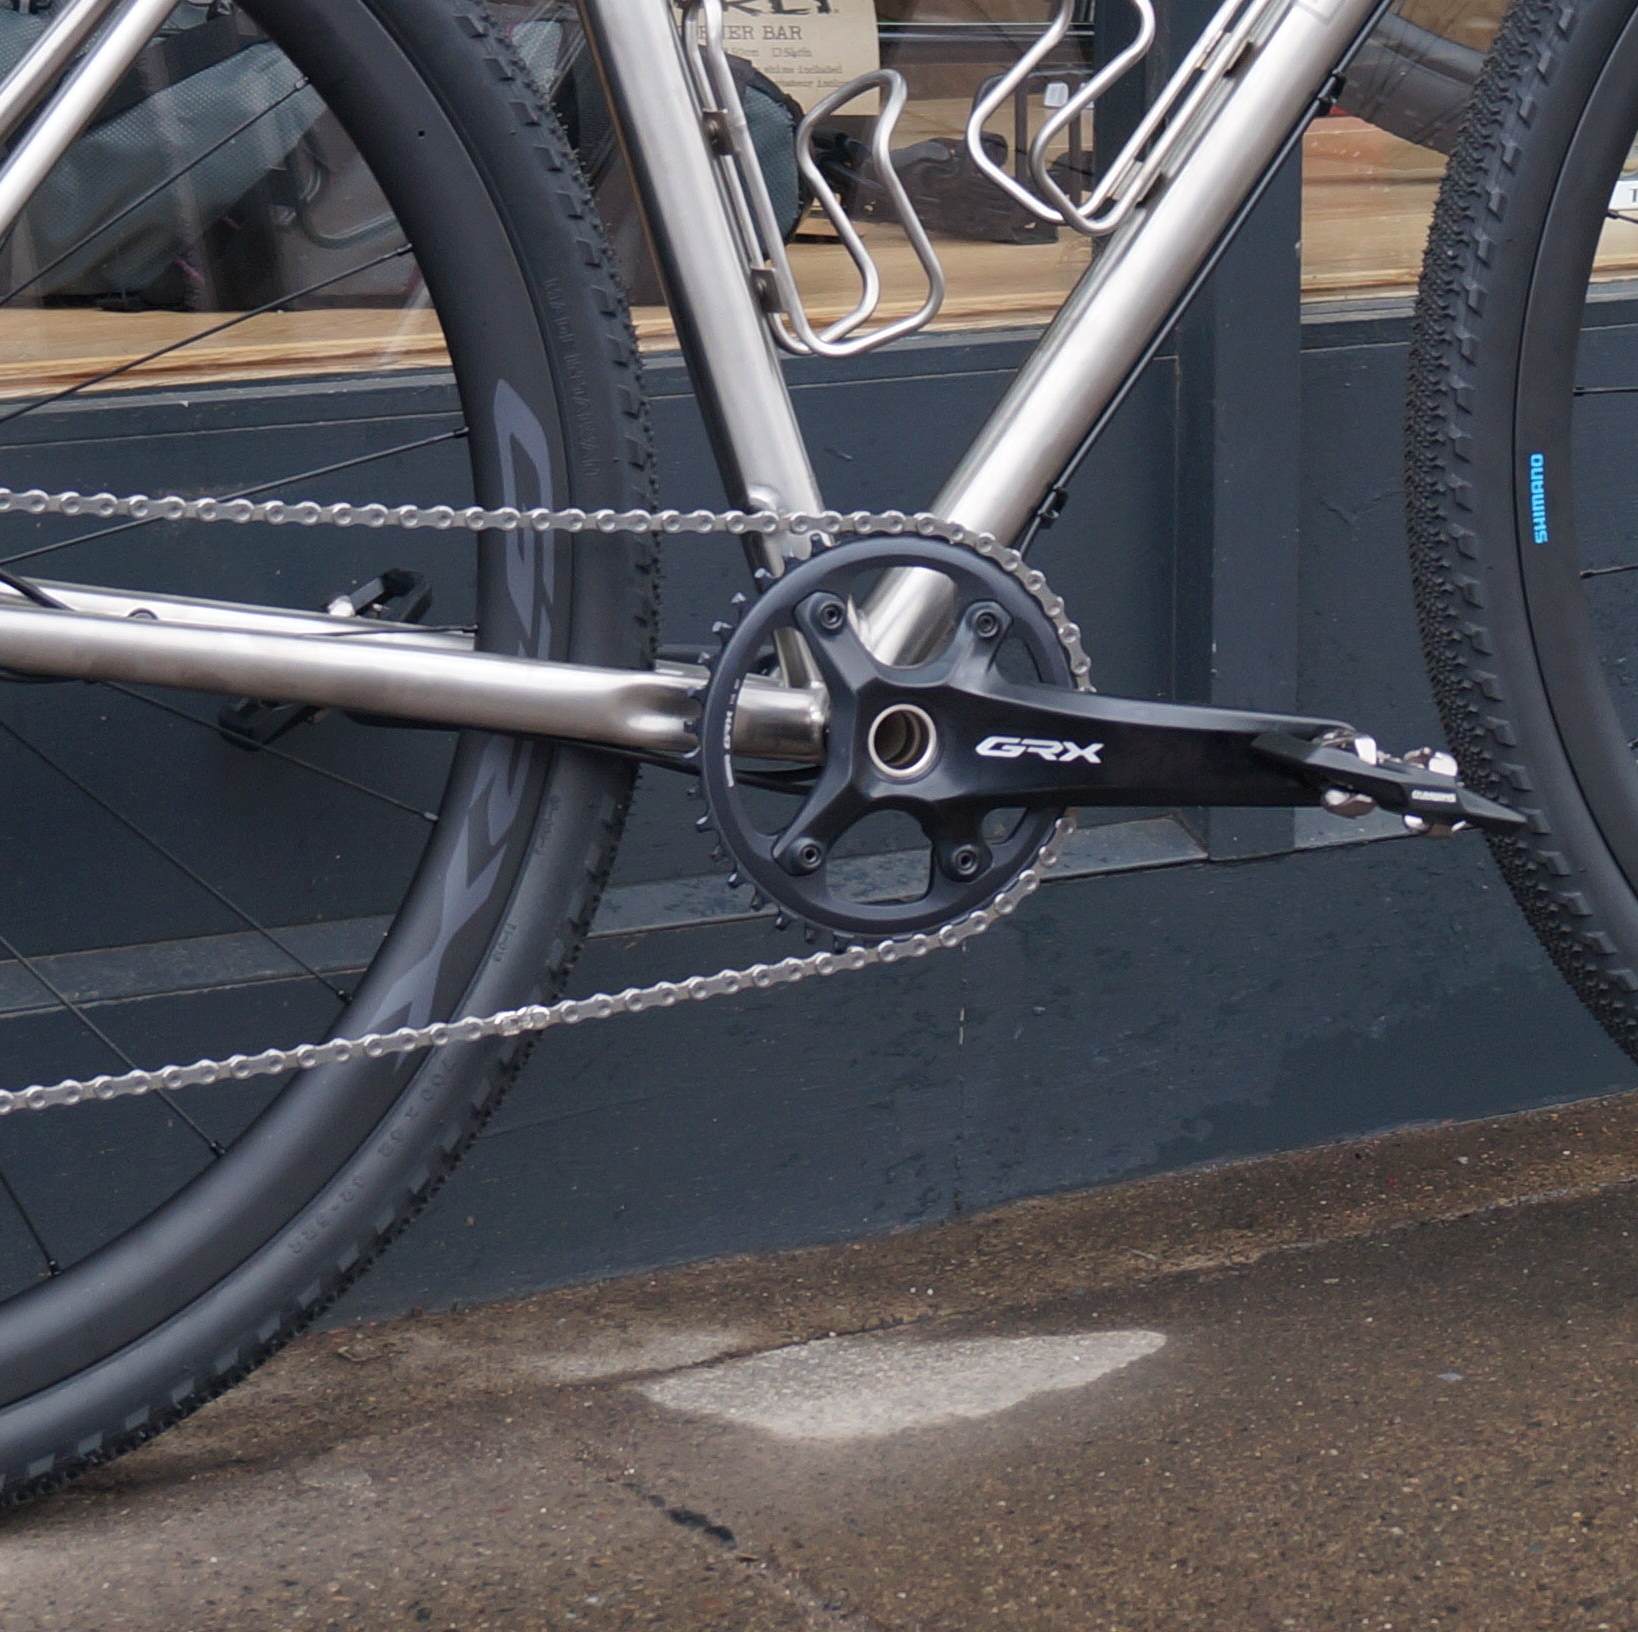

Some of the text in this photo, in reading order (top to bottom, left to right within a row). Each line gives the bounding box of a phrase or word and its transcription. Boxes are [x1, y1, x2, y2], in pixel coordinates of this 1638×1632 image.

[762, 25, 804, 41] BAR
[1530, 452, 1546, 545] SHIMANO
[974, 735, 1106, 765] GRX
